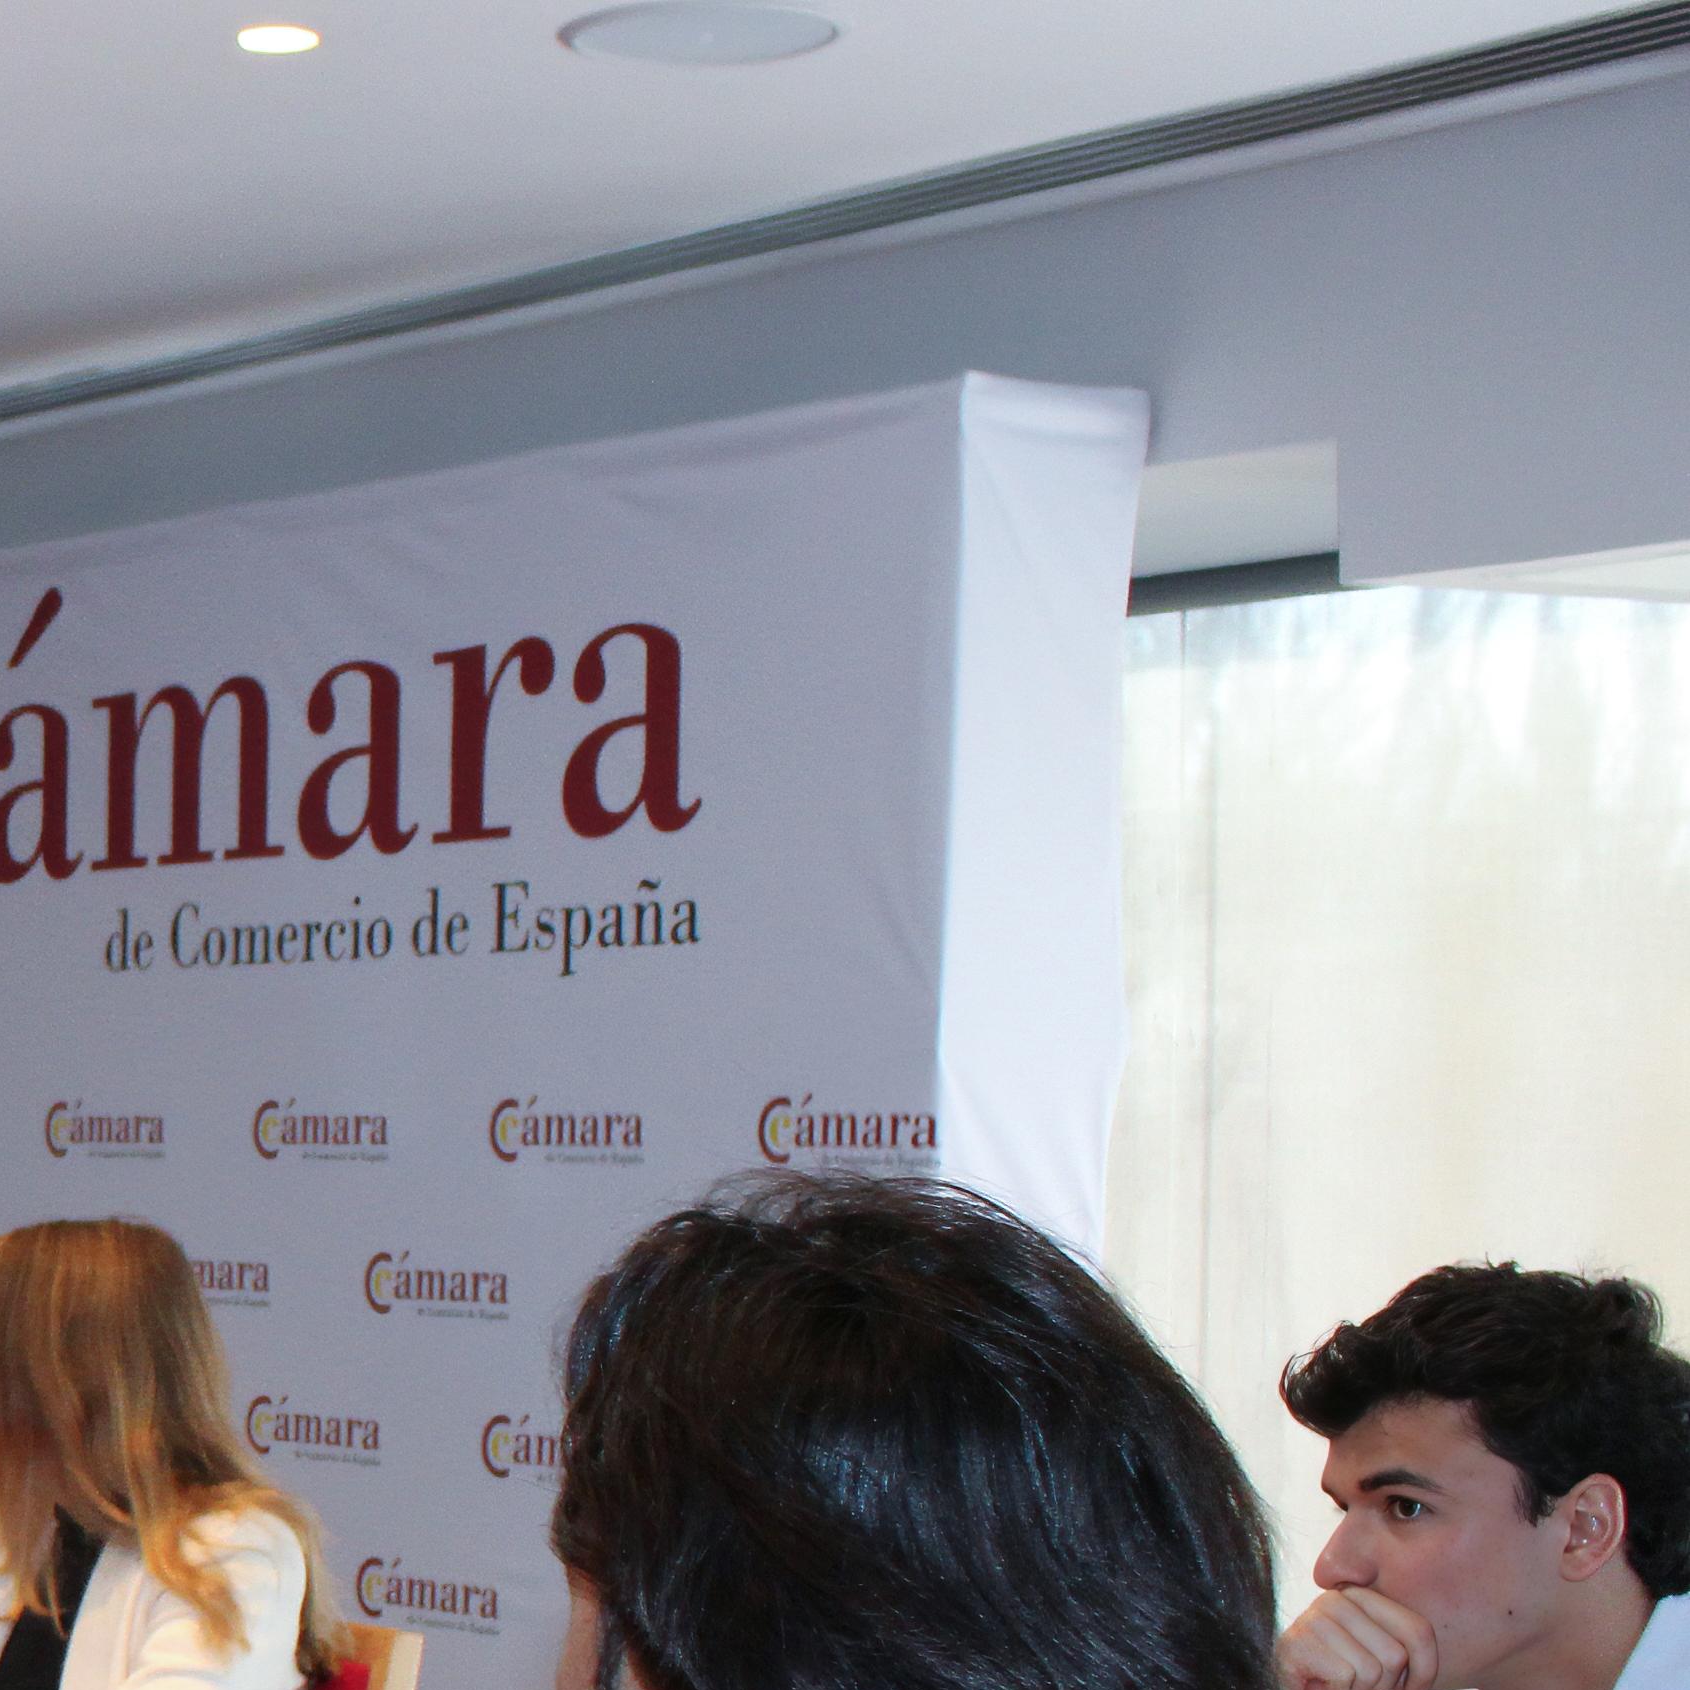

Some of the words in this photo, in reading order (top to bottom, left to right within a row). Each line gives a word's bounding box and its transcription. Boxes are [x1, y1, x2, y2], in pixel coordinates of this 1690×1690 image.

[104, 908, 154, 973] de
[169, 896, 394, 969] Comercio
[410, 887, 471, 957] de
[489, 878, 703, 978] España
